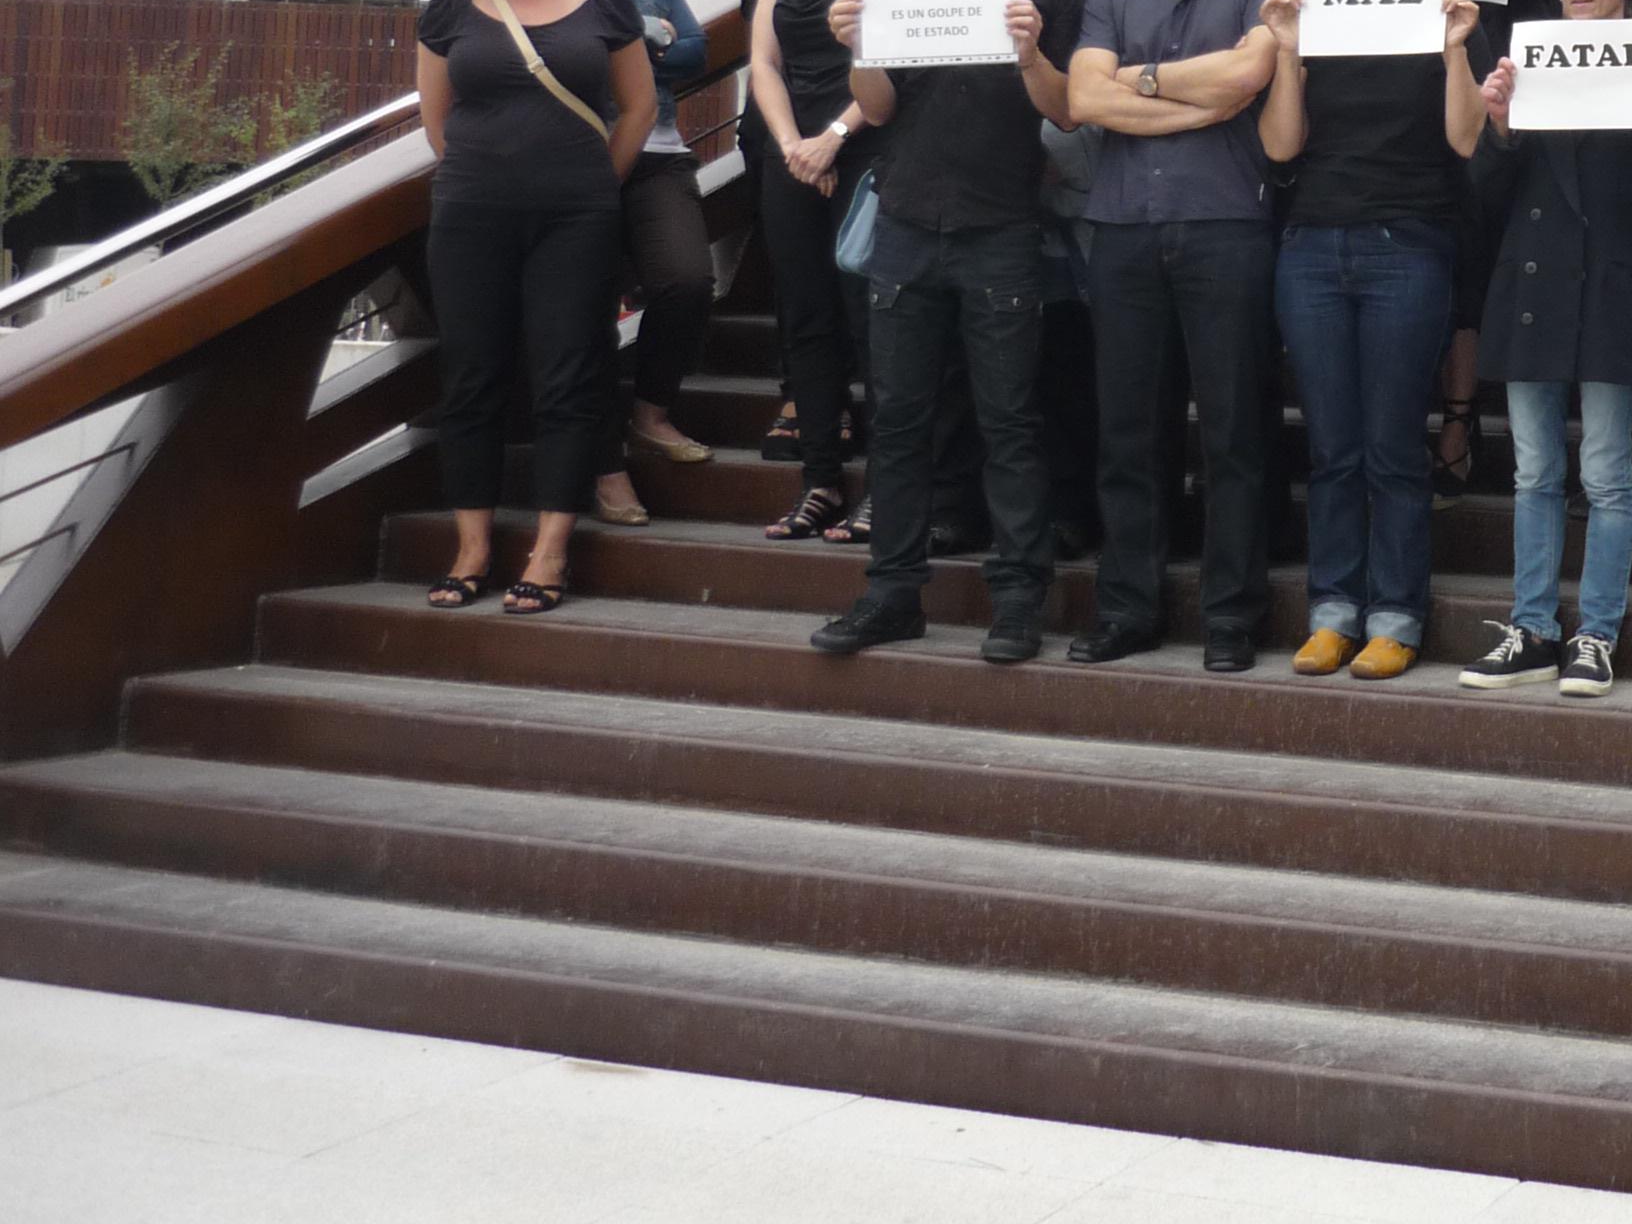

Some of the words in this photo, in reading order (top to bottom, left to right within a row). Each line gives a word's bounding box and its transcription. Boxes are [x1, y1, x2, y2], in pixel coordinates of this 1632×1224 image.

[892, 9, 904, 20] ES
[907, 8, 925, 19] UN
[928, 7, 964, 18] GOLPE
[968, 6, 982, 16] DE
[907, 27, 922, 38] DE
[924, 25, 969, 37] ESTADO
